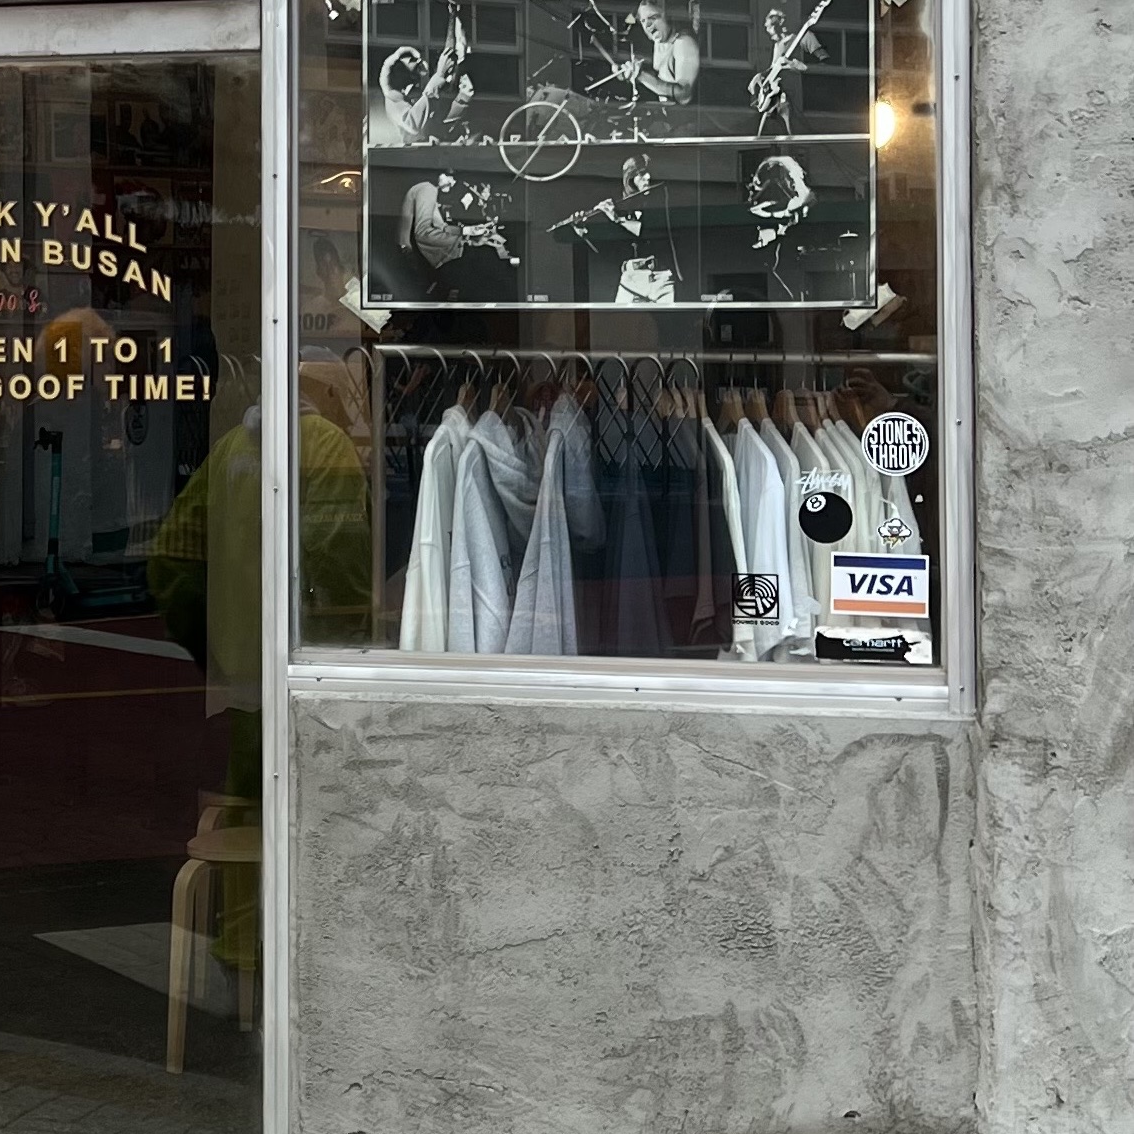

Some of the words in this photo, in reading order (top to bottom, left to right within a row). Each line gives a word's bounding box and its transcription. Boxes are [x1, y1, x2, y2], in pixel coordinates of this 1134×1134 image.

[34, 201, 147, 253] Y'ALL
[44, 240, 172, 303] BUSAN
[54, 338, 68, 363] 1
[90, 338, 137, 363] TO
[158, 338, 172, 363] 1
[104, 375, 210, 400] TIME!
[868, 420, 921, 444] STONES
[870, 444, 920, 468] THROW
[809, 496, 822, 509] 8
[848, 572, 914, 597] VISA
